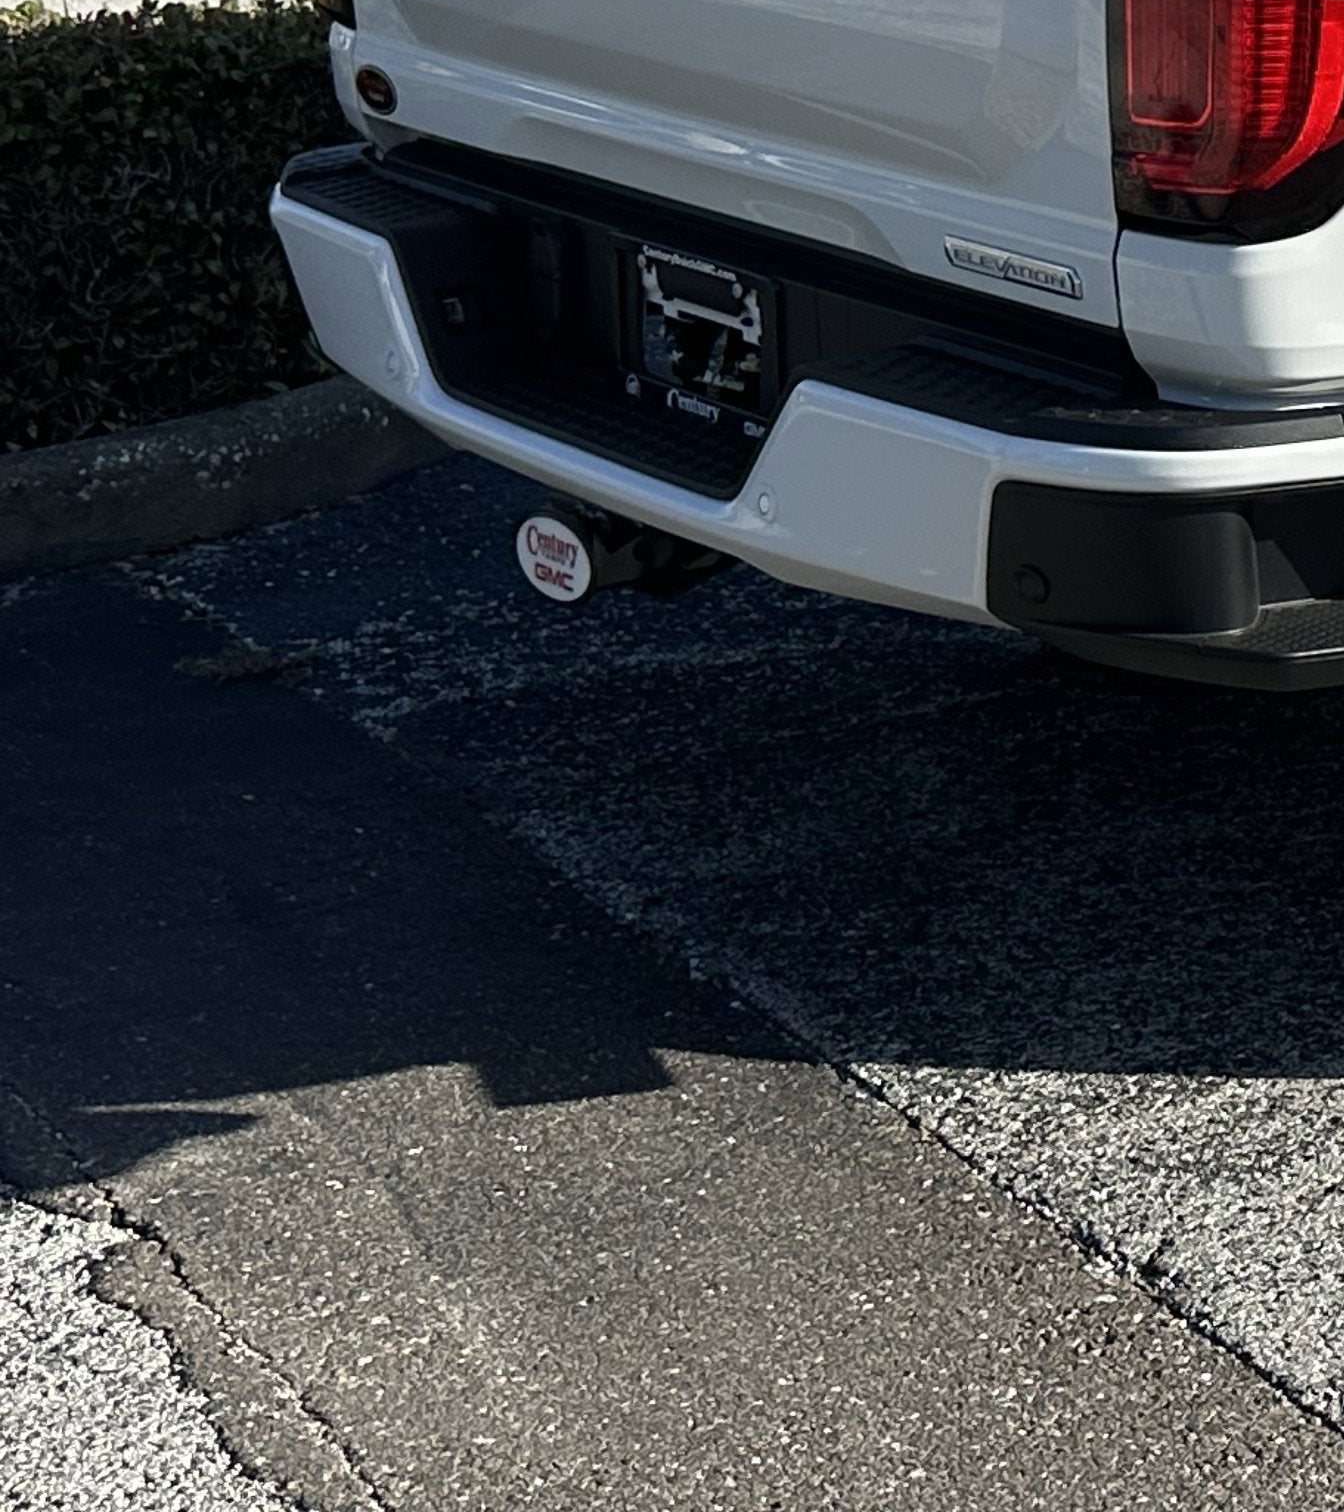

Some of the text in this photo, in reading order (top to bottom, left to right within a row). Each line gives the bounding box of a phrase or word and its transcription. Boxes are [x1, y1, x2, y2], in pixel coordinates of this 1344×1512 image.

[952, 248, 1067, 289] ELEVATION
[526, 524, 579, 569] Century
[534, 562, 575, 592] GMC
